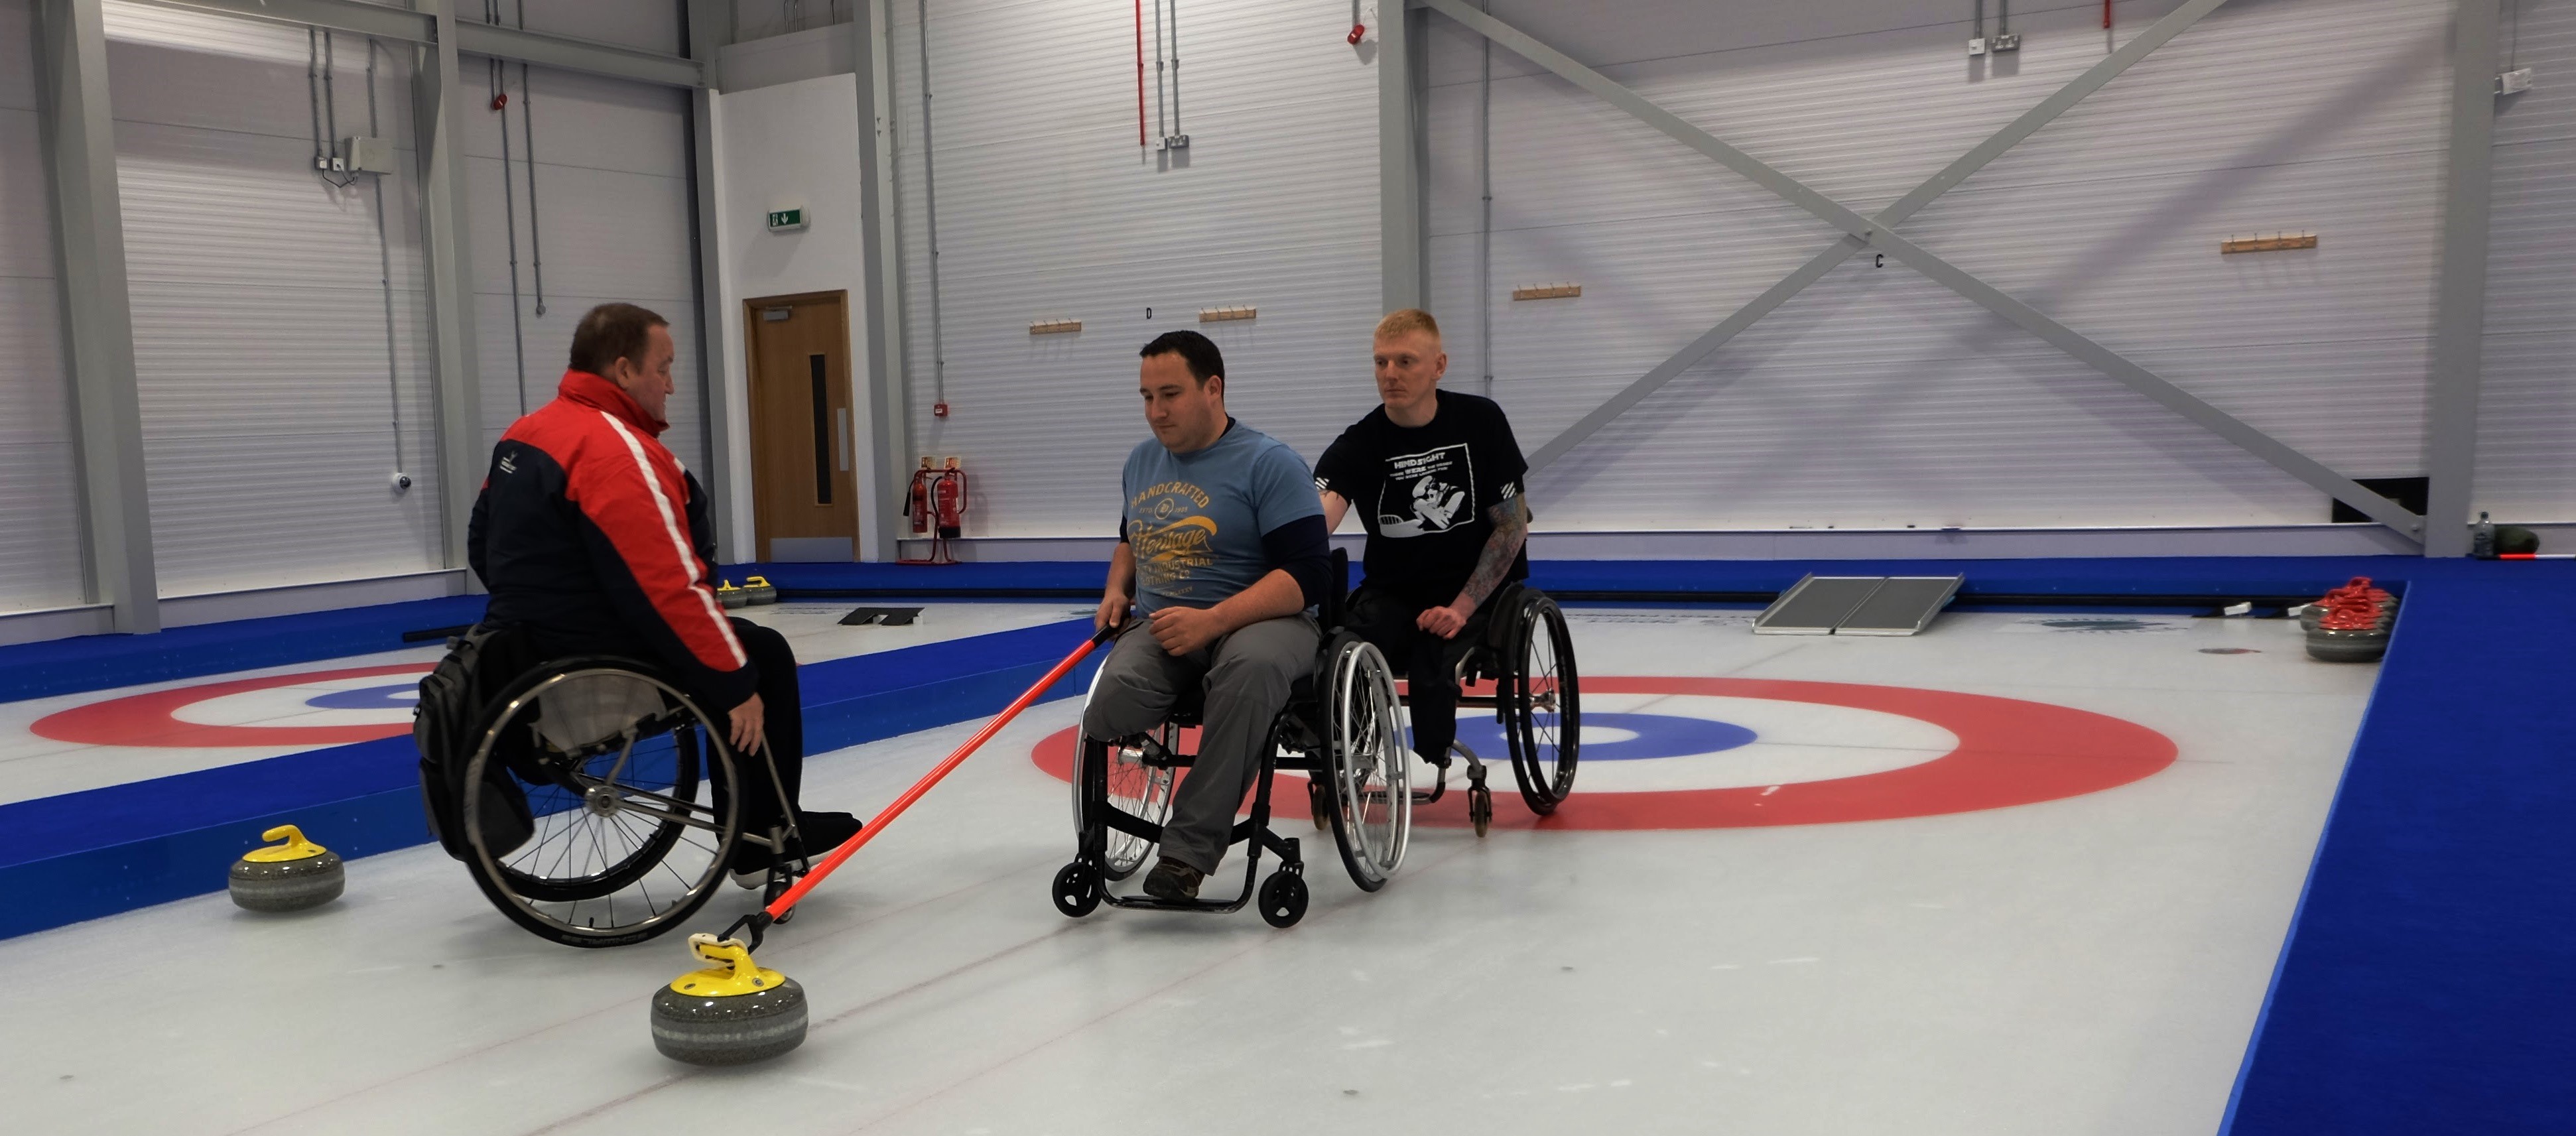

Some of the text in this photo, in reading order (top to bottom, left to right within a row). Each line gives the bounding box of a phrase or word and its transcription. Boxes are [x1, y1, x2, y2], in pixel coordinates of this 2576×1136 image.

[1876, 254, 1884, 268] C
[1146, 307, 1152, 319] D
[1130, 481, 1210, 509] HANDCRAFTED
[1127, 516, 1216, 558] Heritage
